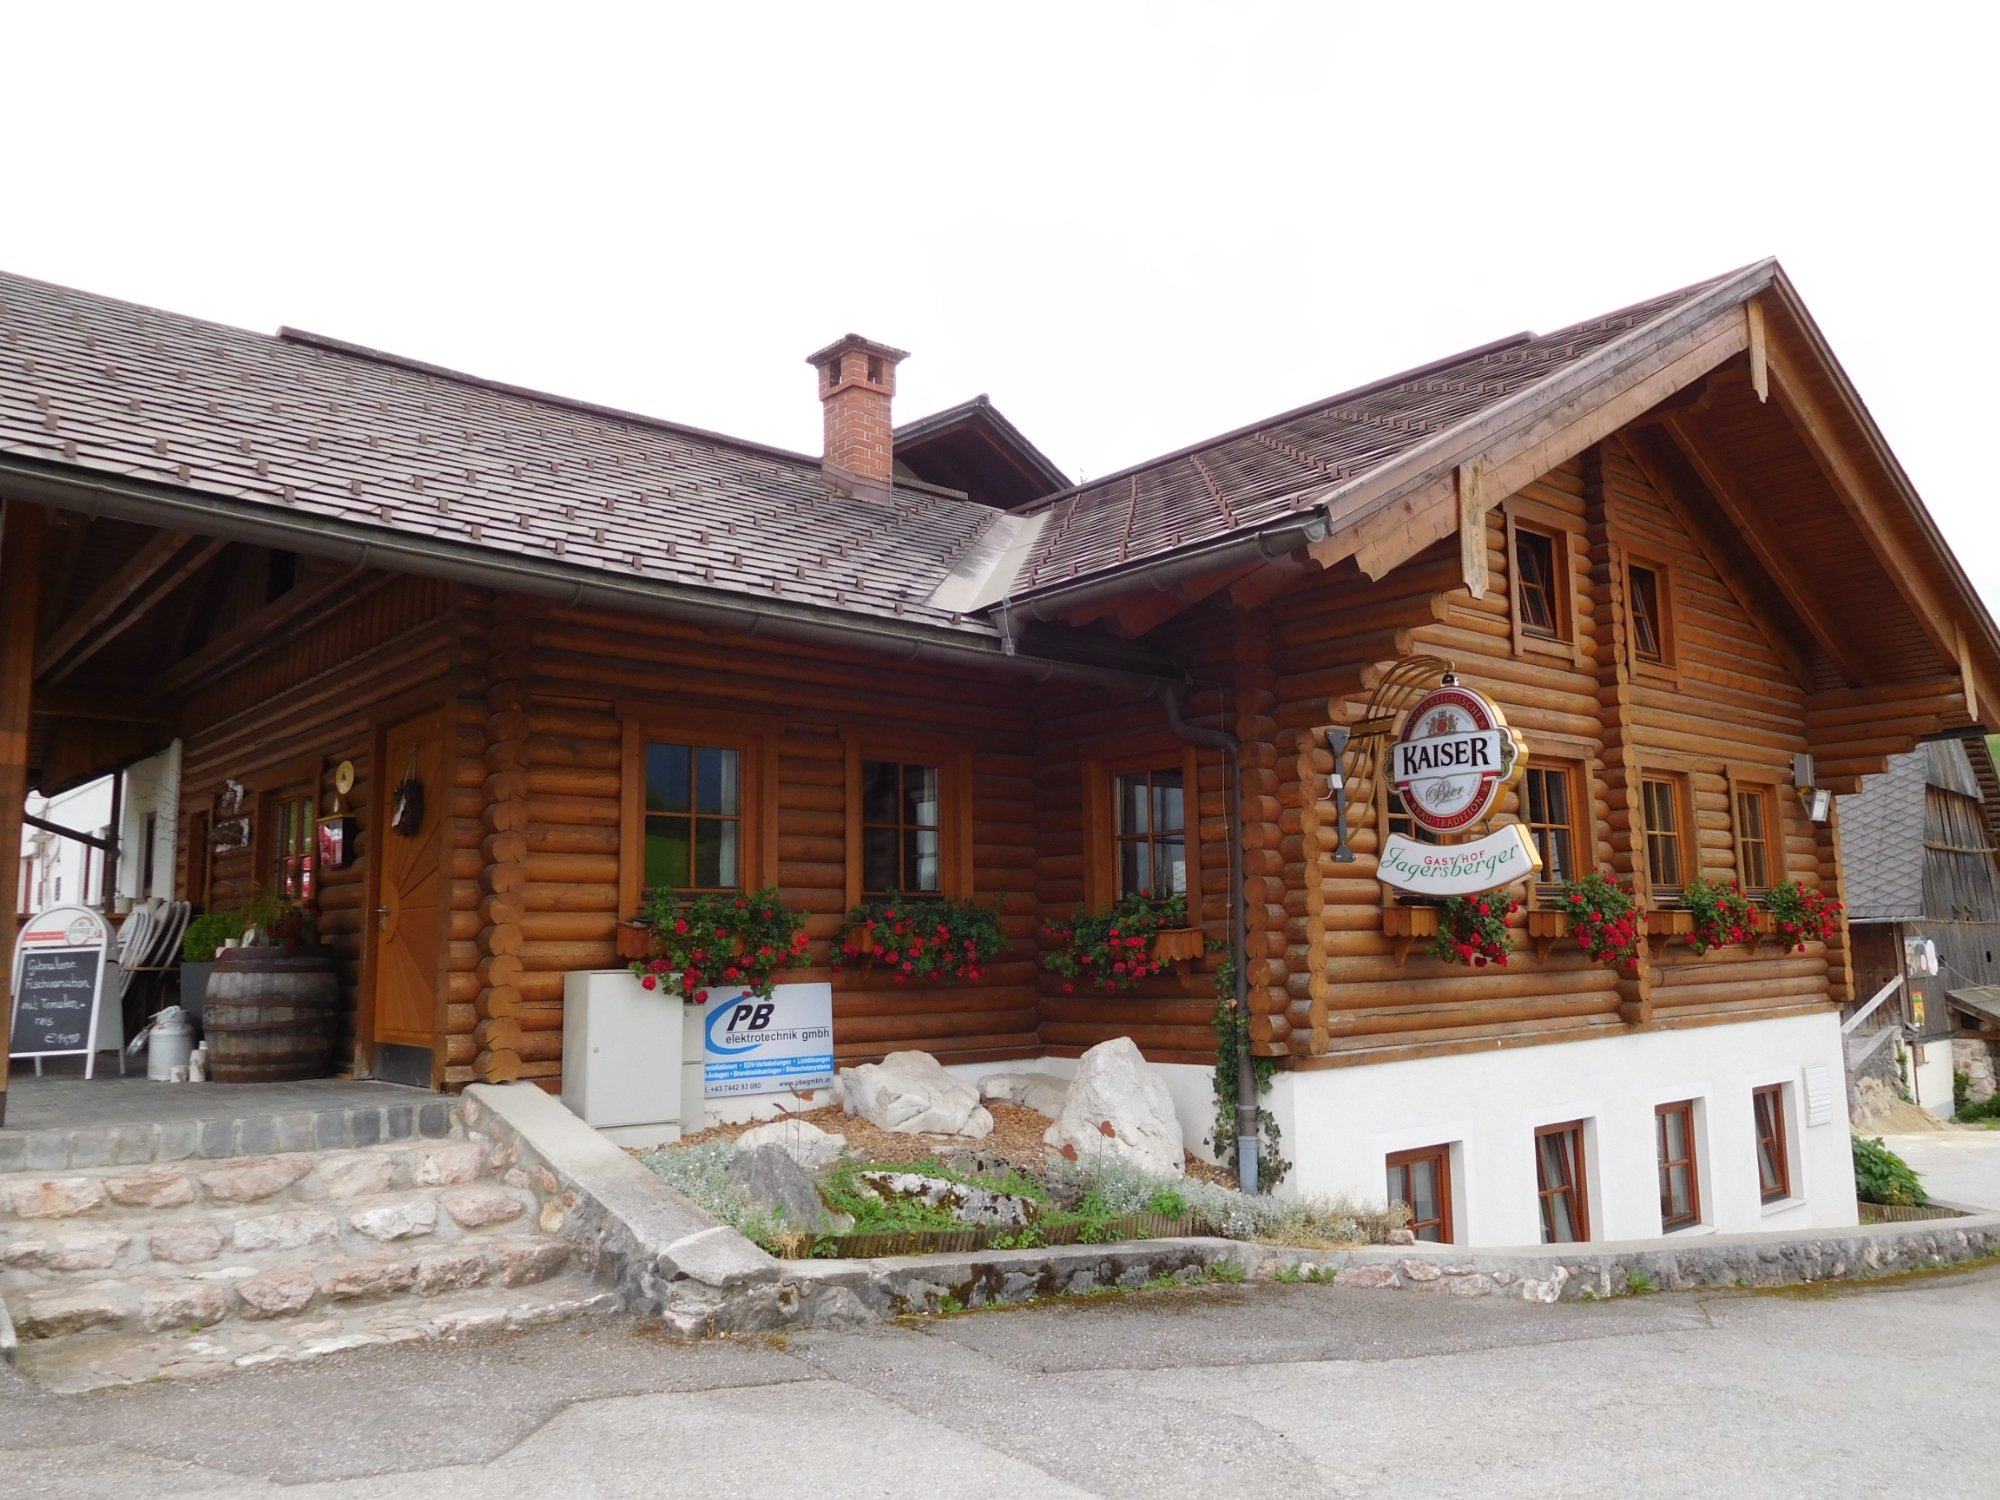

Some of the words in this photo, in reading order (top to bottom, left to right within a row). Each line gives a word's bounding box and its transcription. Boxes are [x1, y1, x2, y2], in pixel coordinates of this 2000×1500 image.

[1402, 737, 1491, 776] KAISER
[1426, 781, 1464, 807] Bier
[726, 1003, 775, 1032] PB
[725, 1031, 798, 1044] elektrotechnik
[801, 1029, 830, 1042] gmbh
[705, 1063, 738, 1071] nstallationen
[724, 1083, 740, 1091] 7442
